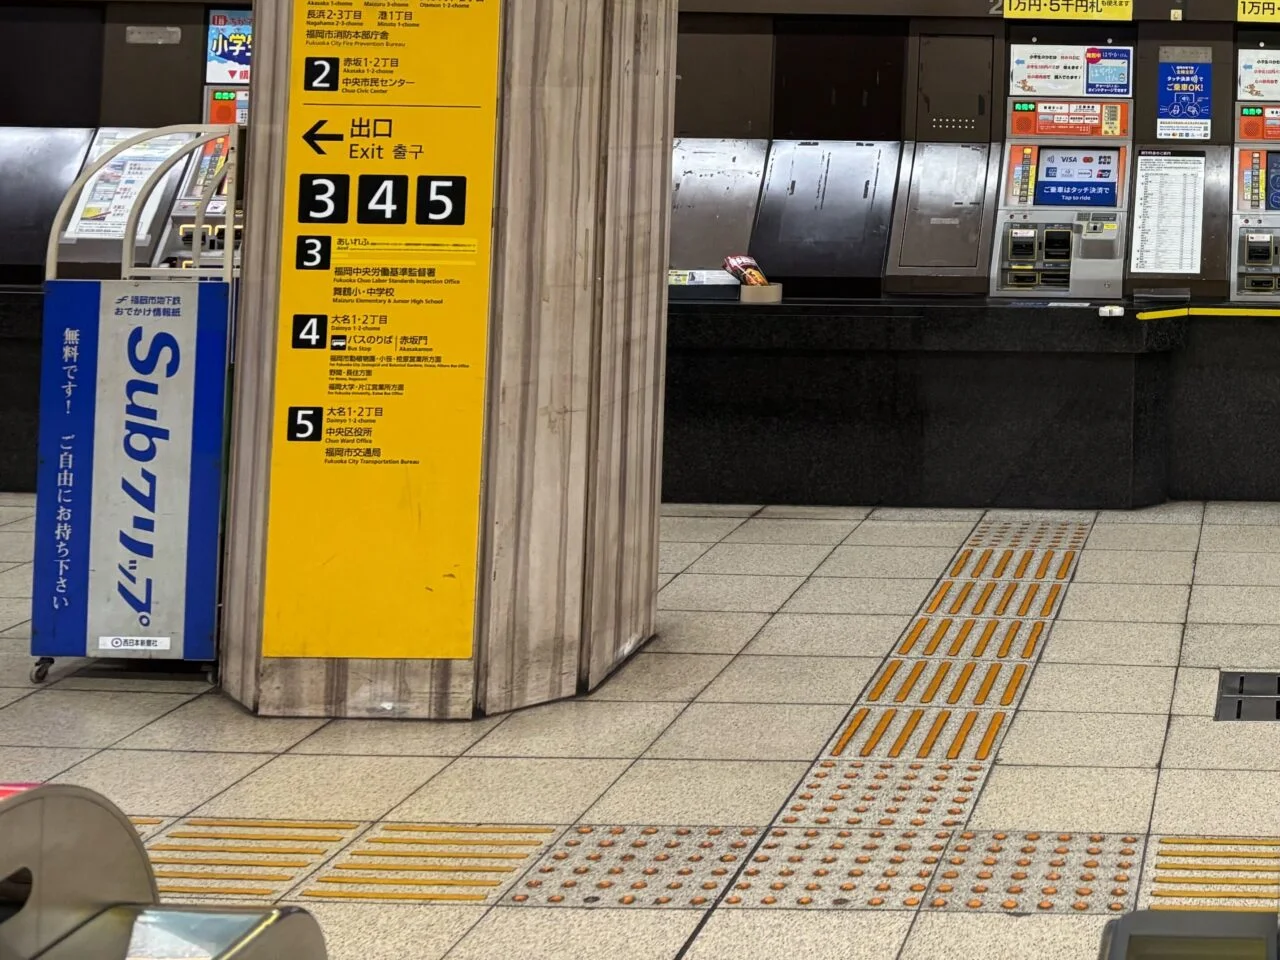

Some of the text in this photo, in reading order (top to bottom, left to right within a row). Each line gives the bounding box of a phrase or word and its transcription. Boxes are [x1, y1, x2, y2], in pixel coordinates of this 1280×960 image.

[312, 60, 330, 87] 2
[342, 77, 415, 87] 中央市民センター
[350, 118, 393, 138] 出口
[350, 144, 384, 159] Exit
[392, 144, 424, 159] 출구
[1044, 186, 1110, 194] ご乗車はタッチ決済で
[309, 178, 453, 220] 3 4 5
[303, 239, 321, 266] 3
[130, 295, 181, 305] 福岡市地下鉄
[114, 307, 181, 317] おでかけ情報紙
[299, 318, 320, 345] 4
[348, 335, 393, 345] バスのりば
[400, 335, 428, 345] 赤坂門
[296, 410, 314, 437] 5
[326, 427, 372, 437] 中央区役所
[52, 327, 80, 609] 無料です！ ご自由にお持ち下さい
[117, 325, 181, 627] Subクリップ
[122, 638, 158, 648] 西日本新聞社
